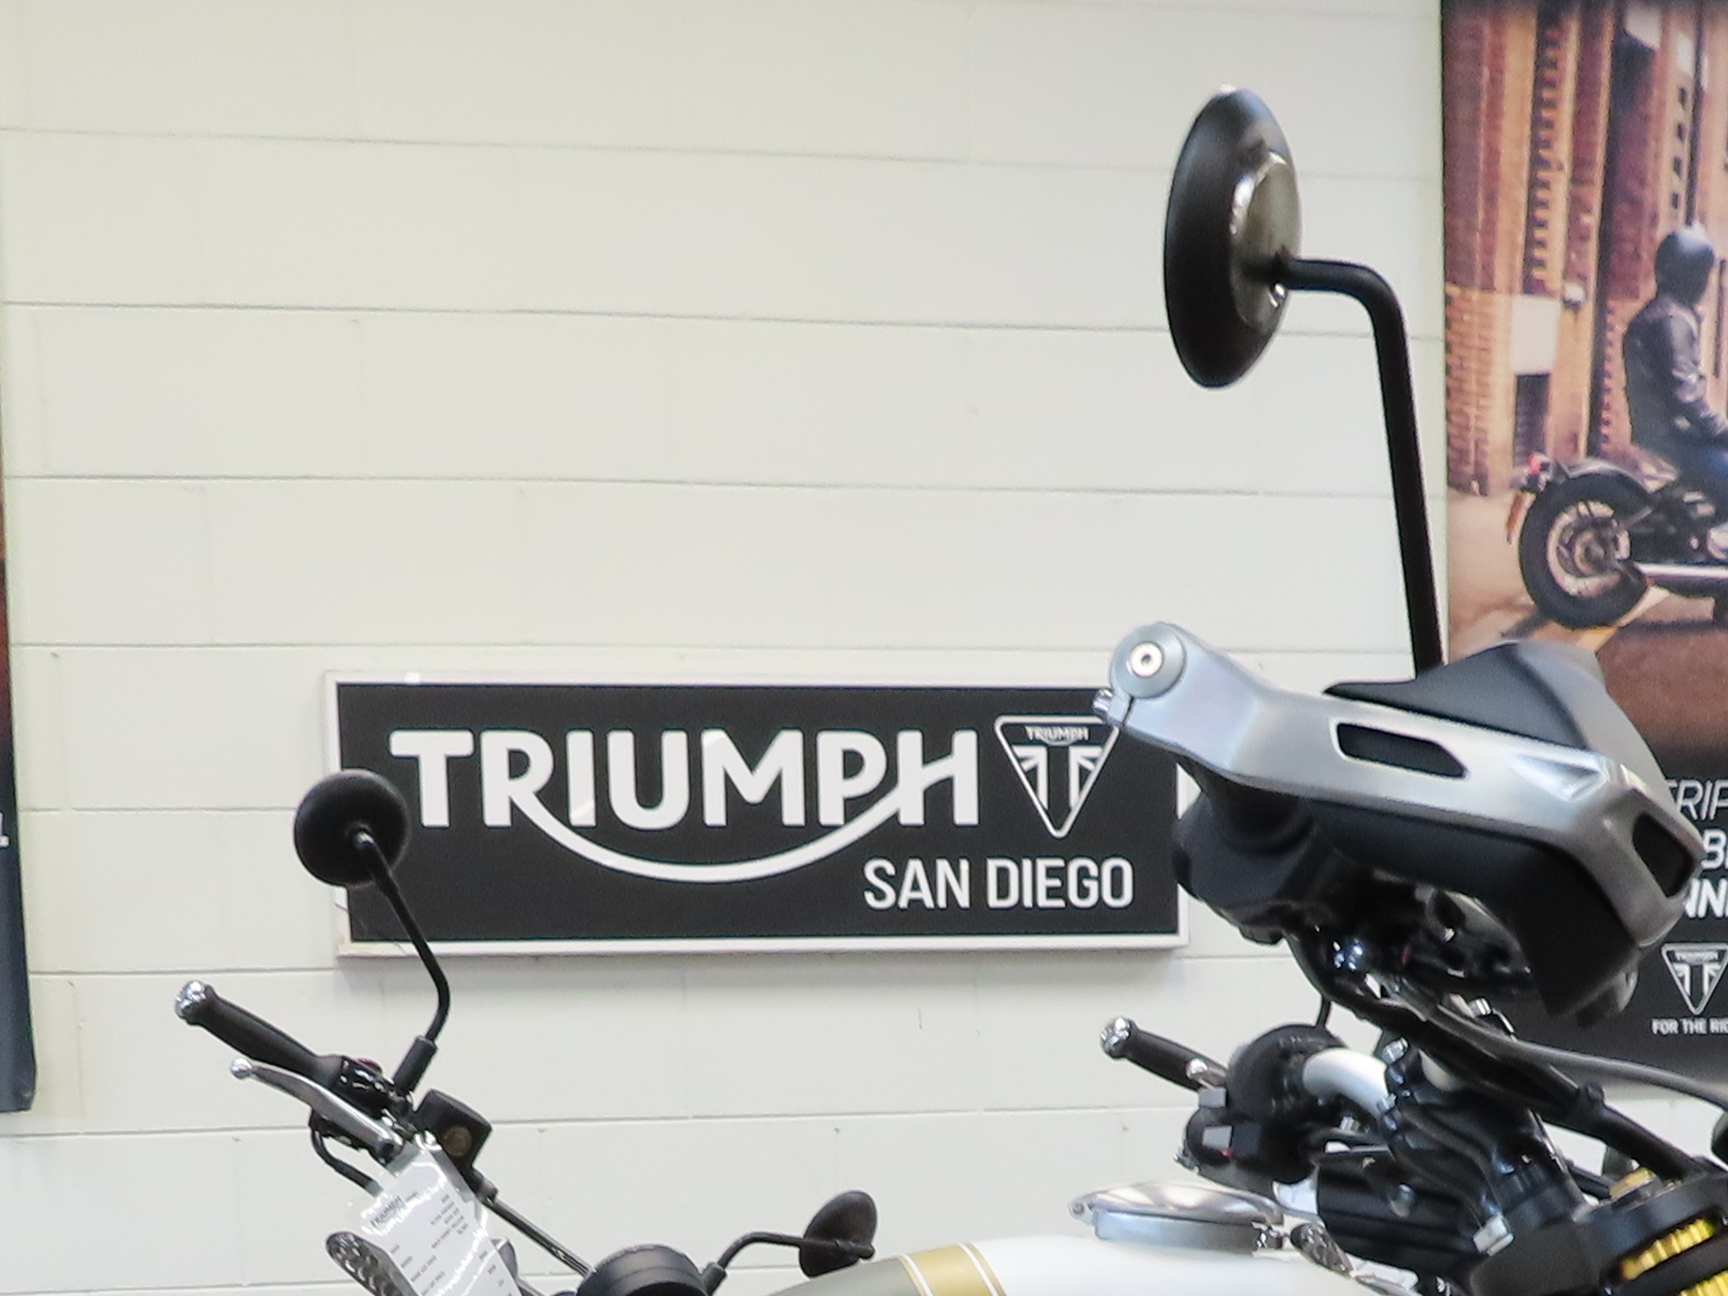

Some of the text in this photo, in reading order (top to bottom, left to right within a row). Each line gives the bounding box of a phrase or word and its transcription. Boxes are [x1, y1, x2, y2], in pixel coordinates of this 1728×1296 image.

[389, 728, 979, 884] TRIUMPH
[863, 856, 1133, 909] SAN DIEGO
[1652, 1018, 1679, 1034] FOR
[1680, 1018, 1707, 1034] THE
